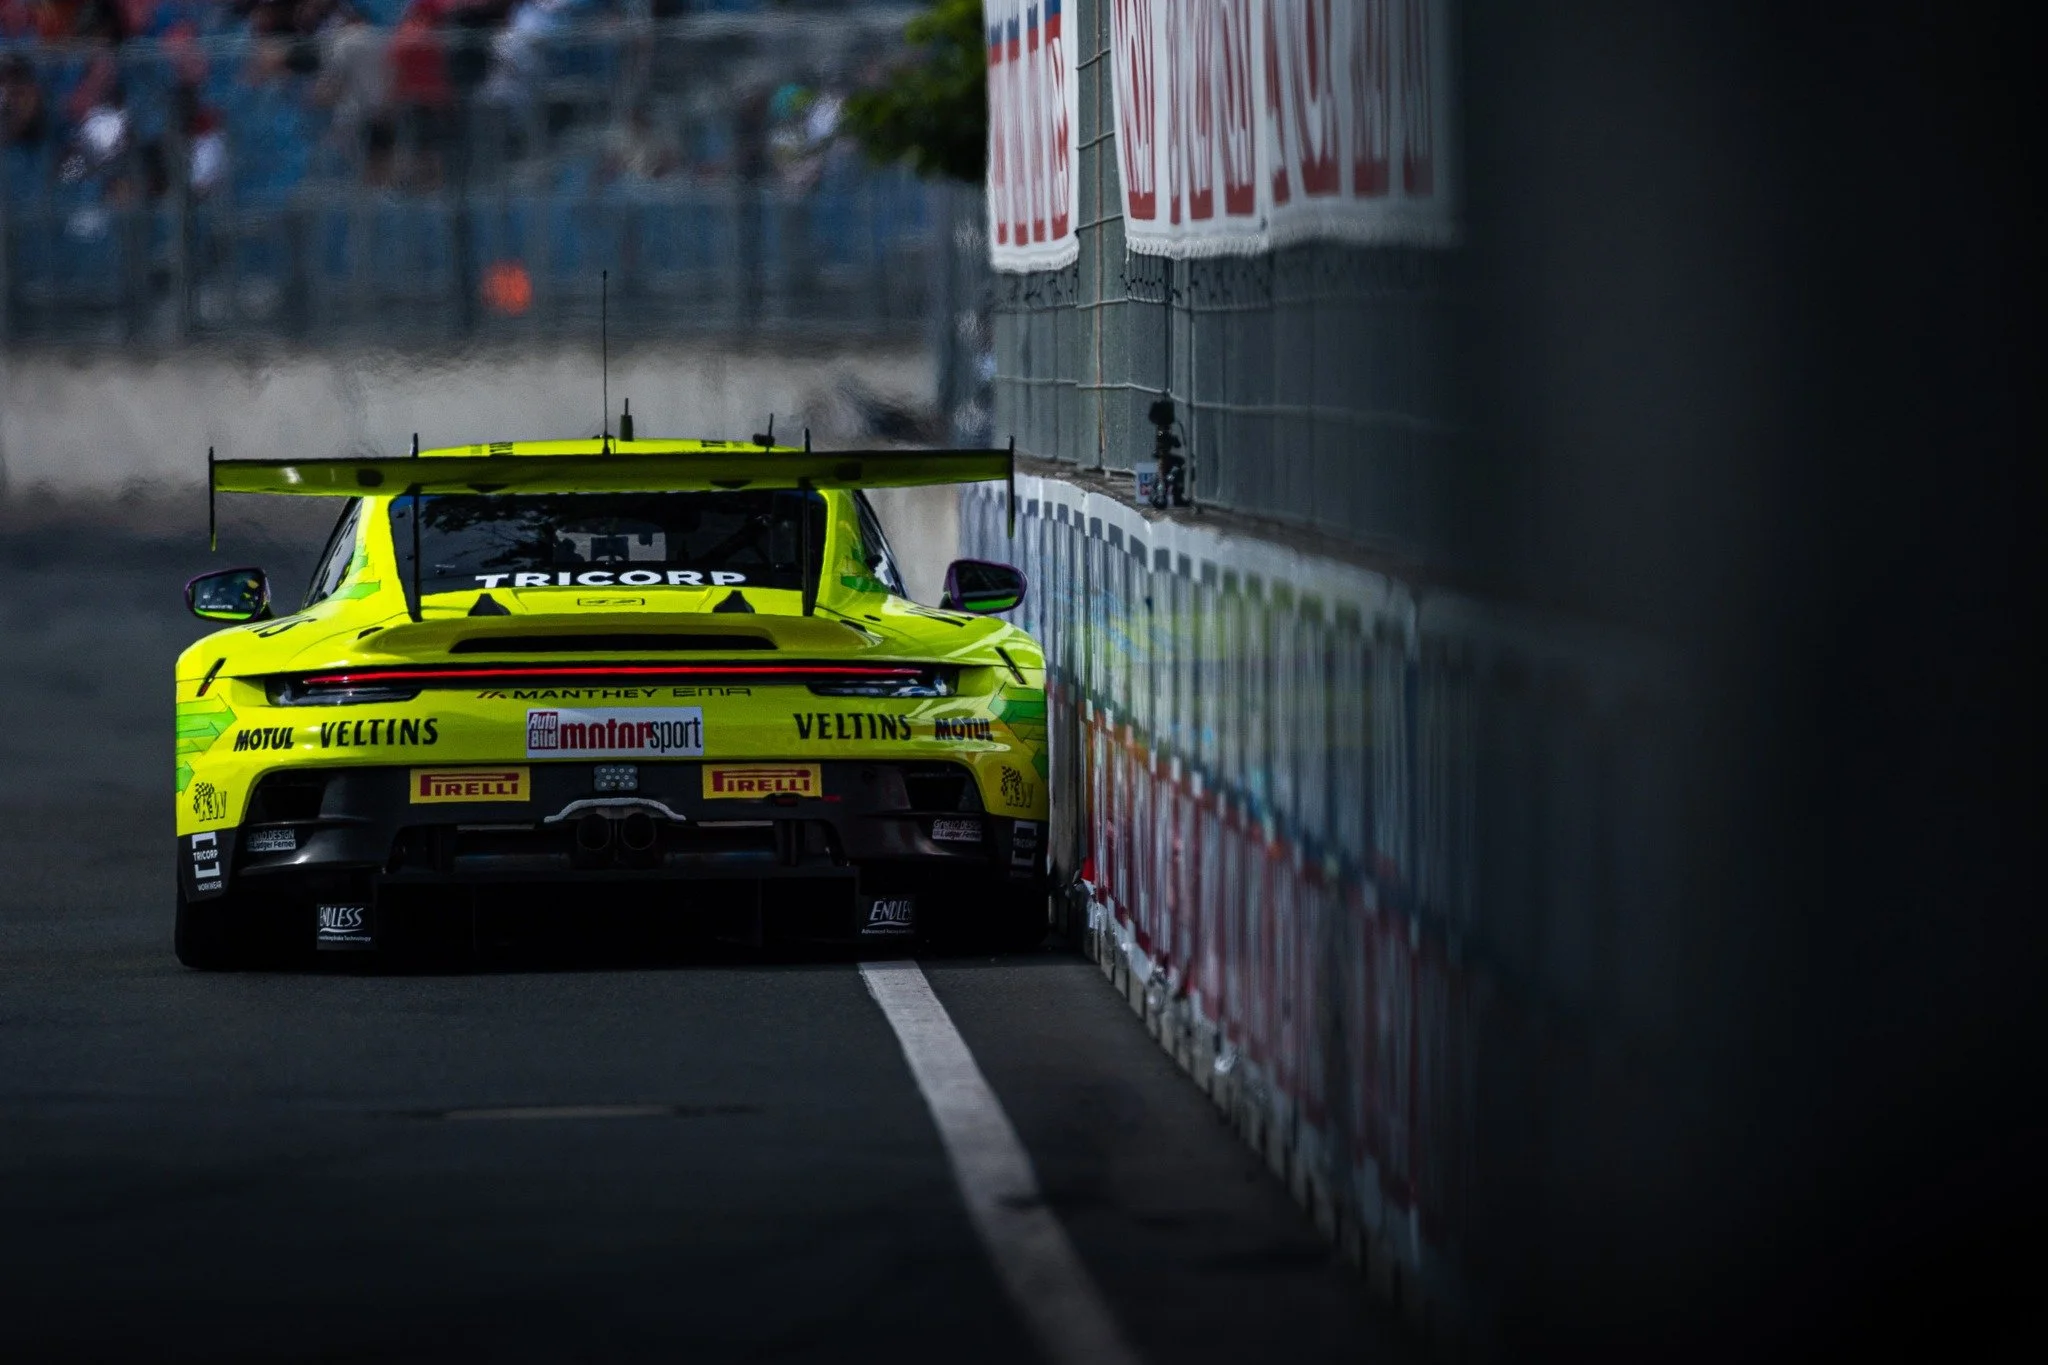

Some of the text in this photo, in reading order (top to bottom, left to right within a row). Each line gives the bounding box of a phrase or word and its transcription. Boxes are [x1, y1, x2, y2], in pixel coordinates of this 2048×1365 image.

[475, 570, 746, 588] TRICORP
[513, 687, 752, 699] MANTHEY EMA
[319, 718, 438, 749] VELTINS
[529, 713, 557, 731] Auto
[793, 713, 912, 741] VELTINS
[934, 718, 993, 741] MOTUL
[233, 726, 294, 752] MOTUL
[530, 729, 557, 748] Bild
[560, 717, 702, 753] motorsport
[420, 772, 518, 797] PIRELLI
[712, 769, 811, 794] PIRELLI
[198, 790, 227, 822] KW
[193, 849, 218, 861] TRICORP
[320, 907, 364, 927] ENDLESS
